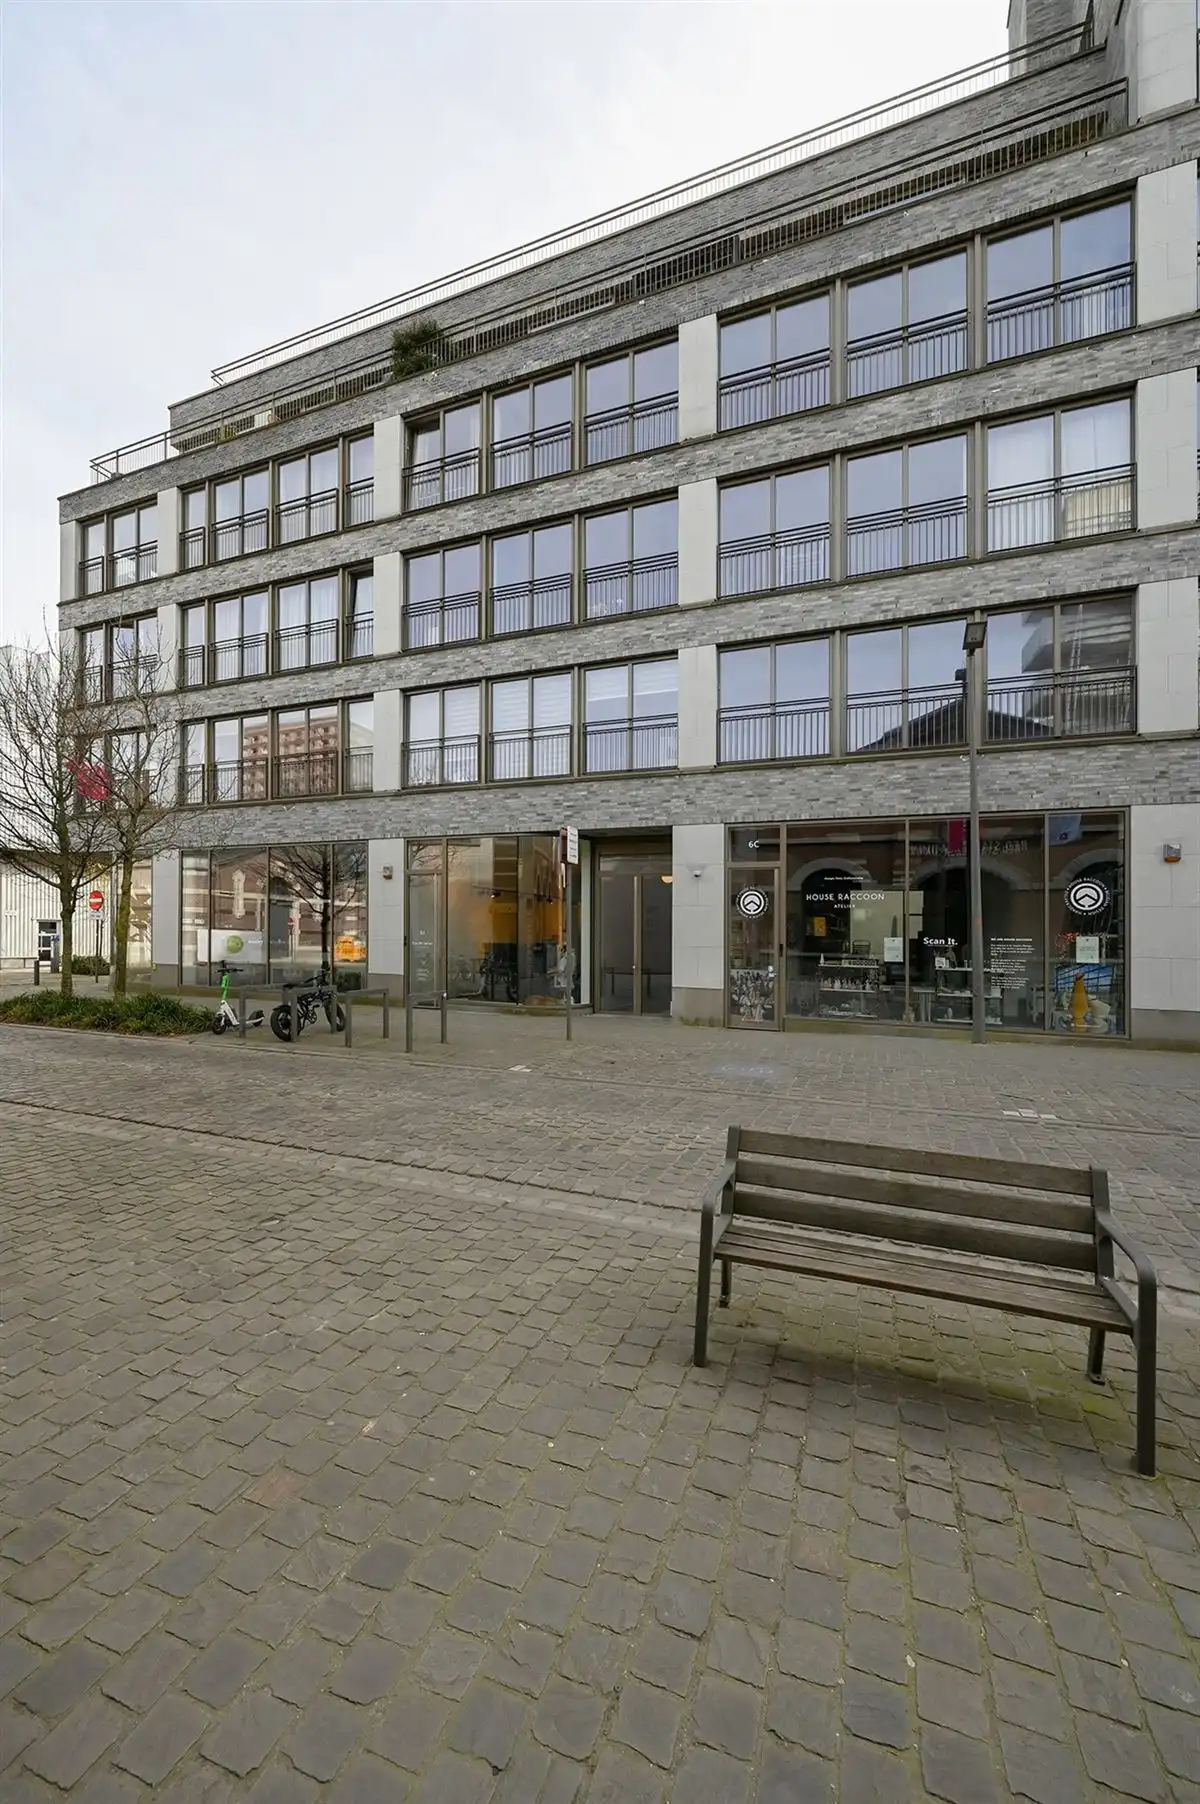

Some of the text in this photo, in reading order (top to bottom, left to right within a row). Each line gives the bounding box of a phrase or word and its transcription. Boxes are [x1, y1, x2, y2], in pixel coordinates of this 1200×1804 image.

[748, 840, 760, 849] 6C
[806, 892, 885, 901] HOUSE RACCOON
[923, 936, 959, 945] Scan It.
